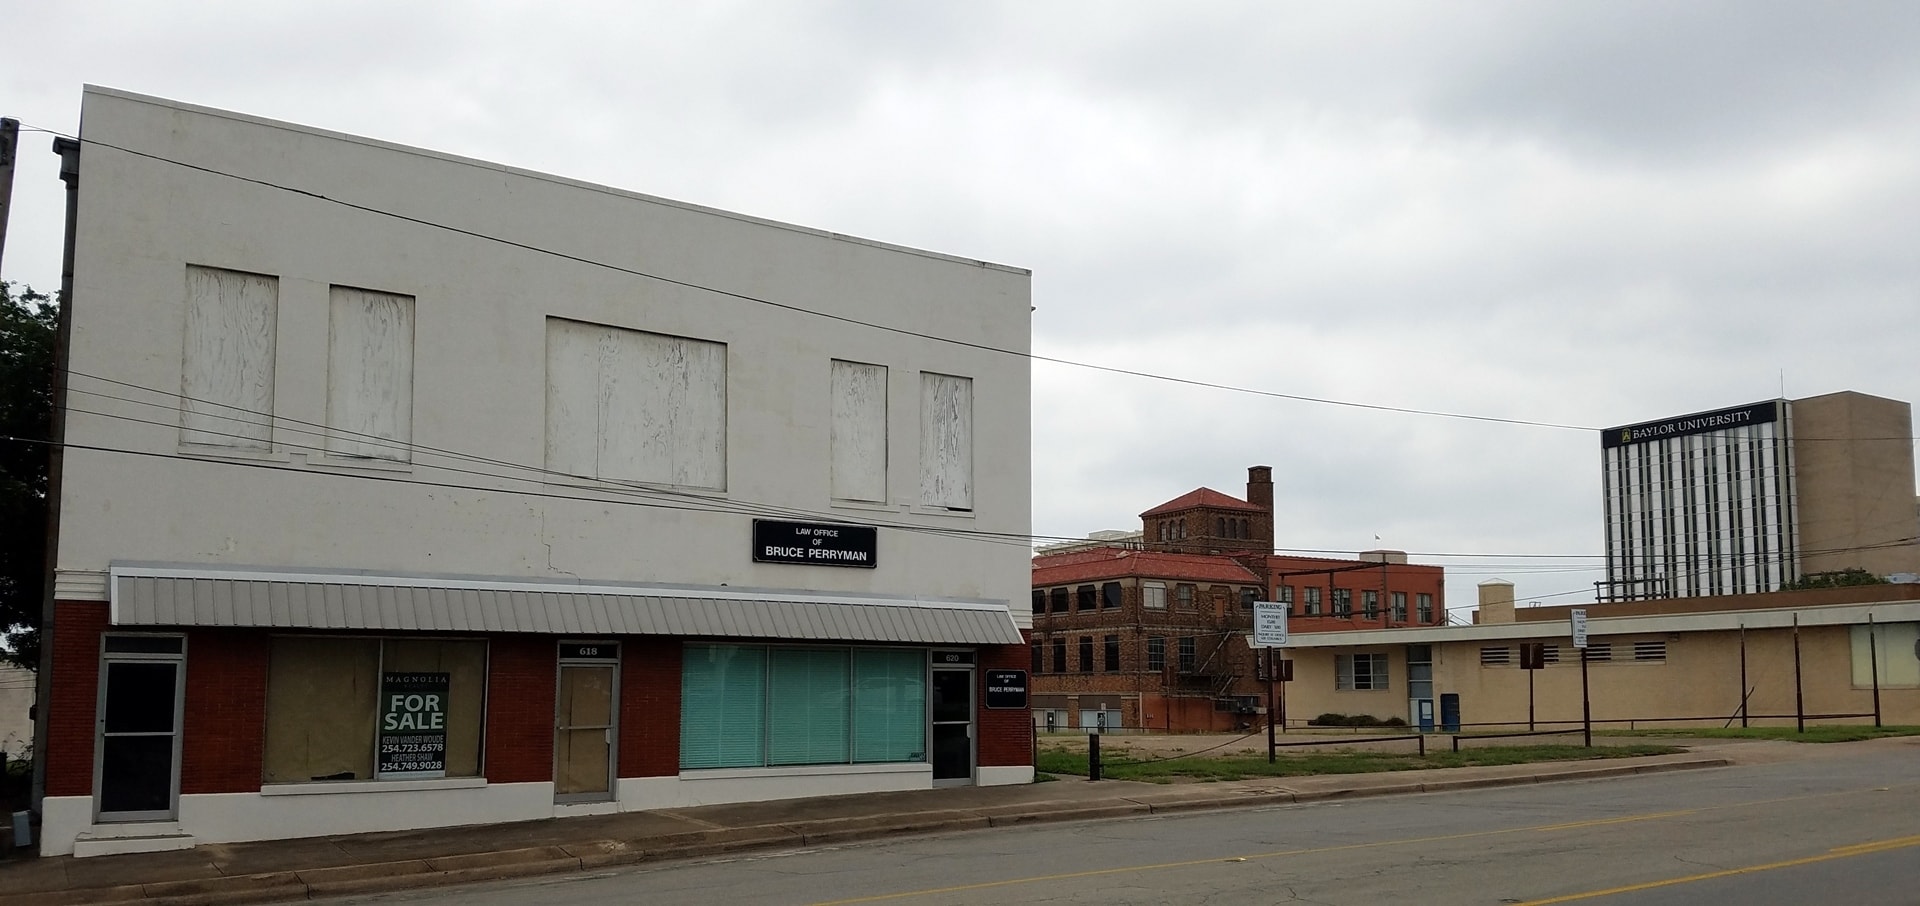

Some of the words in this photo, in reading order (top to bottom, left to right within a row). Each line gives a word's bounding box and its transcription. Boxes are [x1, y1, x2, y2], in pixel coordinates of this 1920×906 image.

[1633, 423, 1675, 439] BAYLOR
[1678, 410, 1752, 432] UNIVERSITY
[795, 527, 812, 535] LAW
[813, 529, 839, 538] OFFICE
[812, 538, 823, 546] OF
[765, 545, 804, 558] BRUCE
[808, 548, 867, 561] PERRYMAN
[579, 647, 598, 656] 618
[945, 654, 960, 662] 620
[391, 694, 440, 712] FOR
[384, 712, 444, 731] SALE
[382, 736, 400, 745] KEVIN
[400, 735, 423, 744] VANDER
[423, 734, 444, 744] WOUDE
[382, 743, 444, 753] 254.723.6578
[391, 753, 416, 762] HEATHER
[417, 752, 434, 762] SHAW
[381, 761, 442, 771] 254.749.9028
